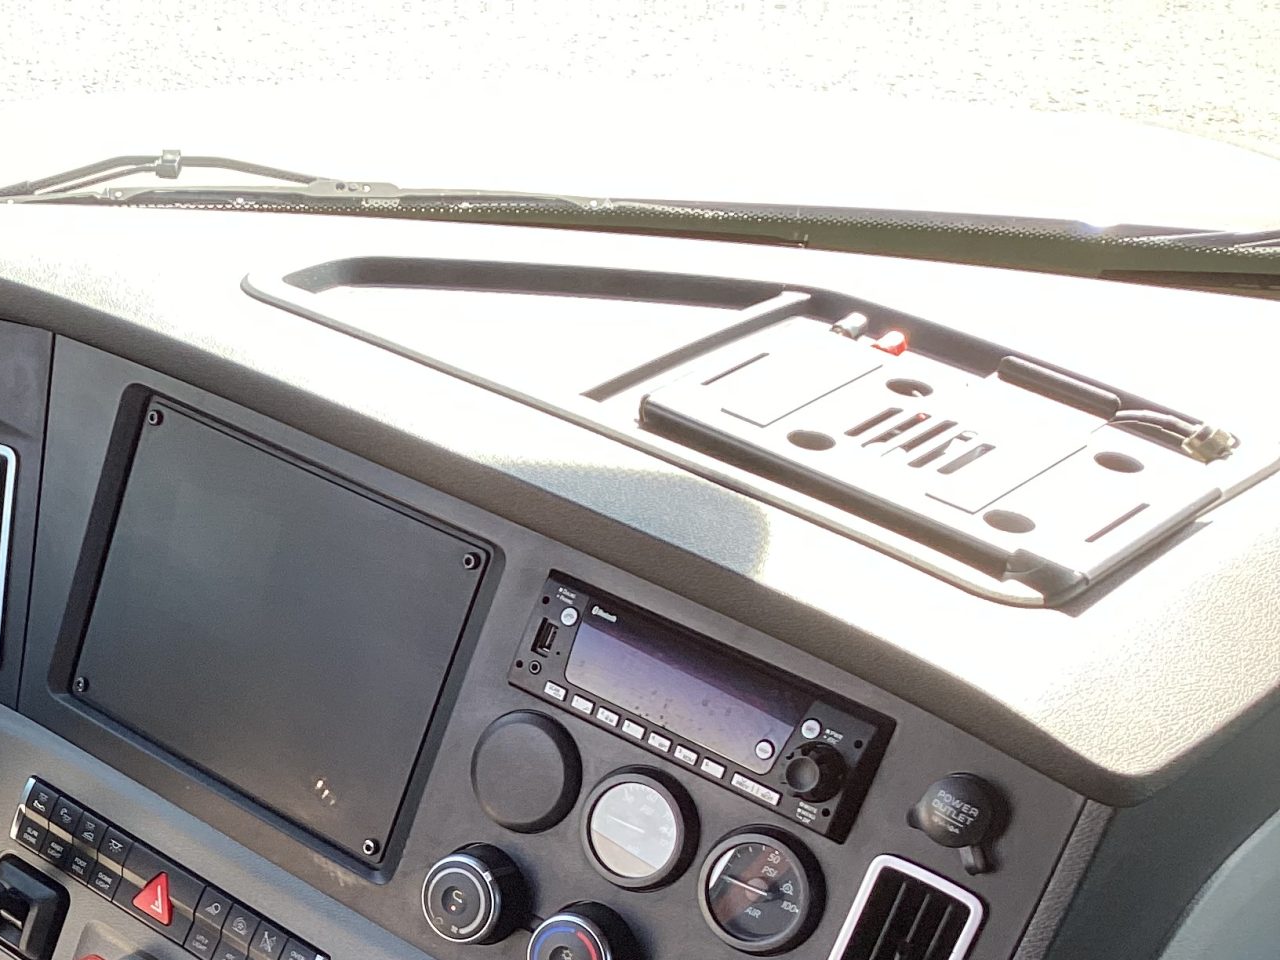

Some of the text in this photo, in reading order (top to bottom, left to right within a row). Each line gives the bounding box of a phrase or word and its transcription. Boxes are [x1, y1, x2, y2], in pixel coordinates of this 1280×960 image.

[937, 789, 979, 817] POWER
[931, 798, 974, 826] OUTLET
[767, 852, 781, 865] 50
[97, 871, 112, 885] DOME
[761, 865, 778, 878] PSI
[95, 878, 110, 890] LIGHT
[744, 906, 762, 919] AIR
[781, 900, 797, 913] 100
